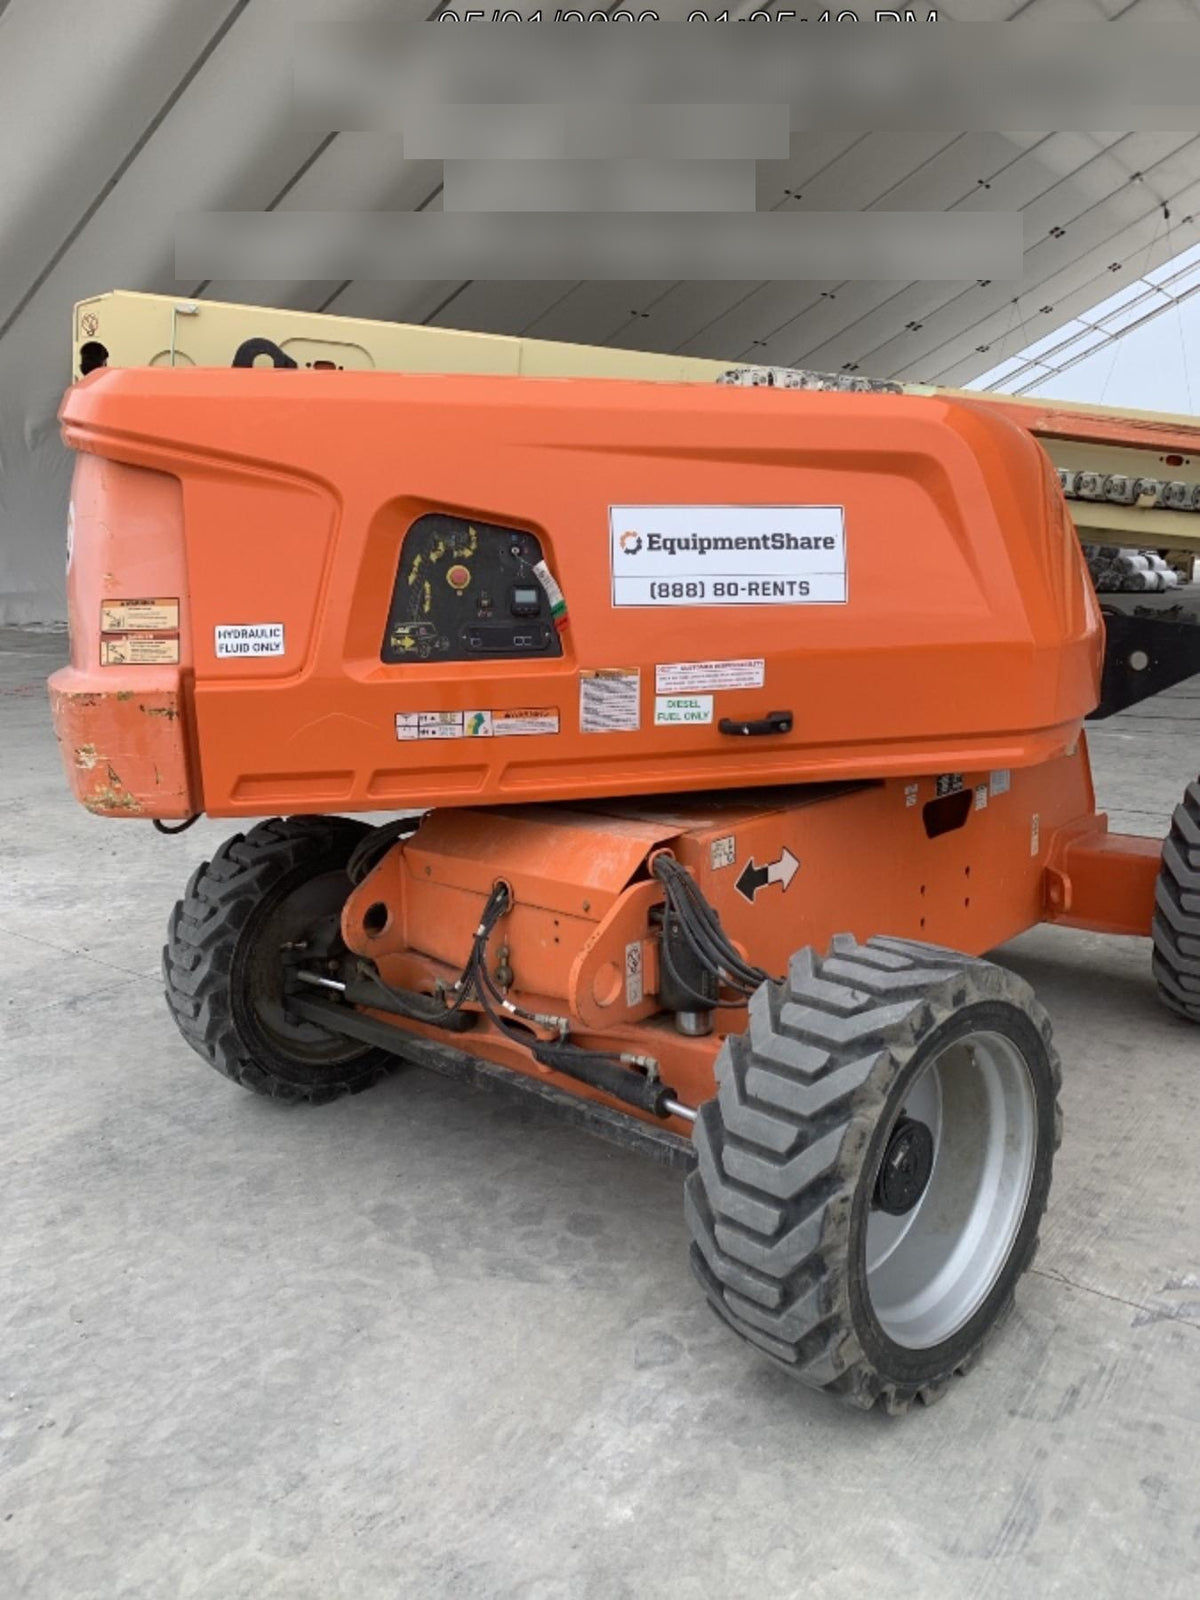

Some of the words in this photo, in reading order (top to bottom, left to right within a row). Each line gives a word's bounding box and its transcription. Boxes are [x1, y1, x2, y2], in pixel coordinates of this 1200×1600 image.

[647, 533, 835, 555] EquipmentShare
[650, 582, 705, 599] (888)
[713, 581, 810, 597] 80-RENTS
[218, 628, 281, 640] HYDRAULIC
[218, 642, 250, 654] FLUID
[251, 641, 281, 653] ONLY
[667, 699, 700, 709] DIESEL
[657, 712, 681, 721] FUEL
[684, 710, 710, 721] ONLY
